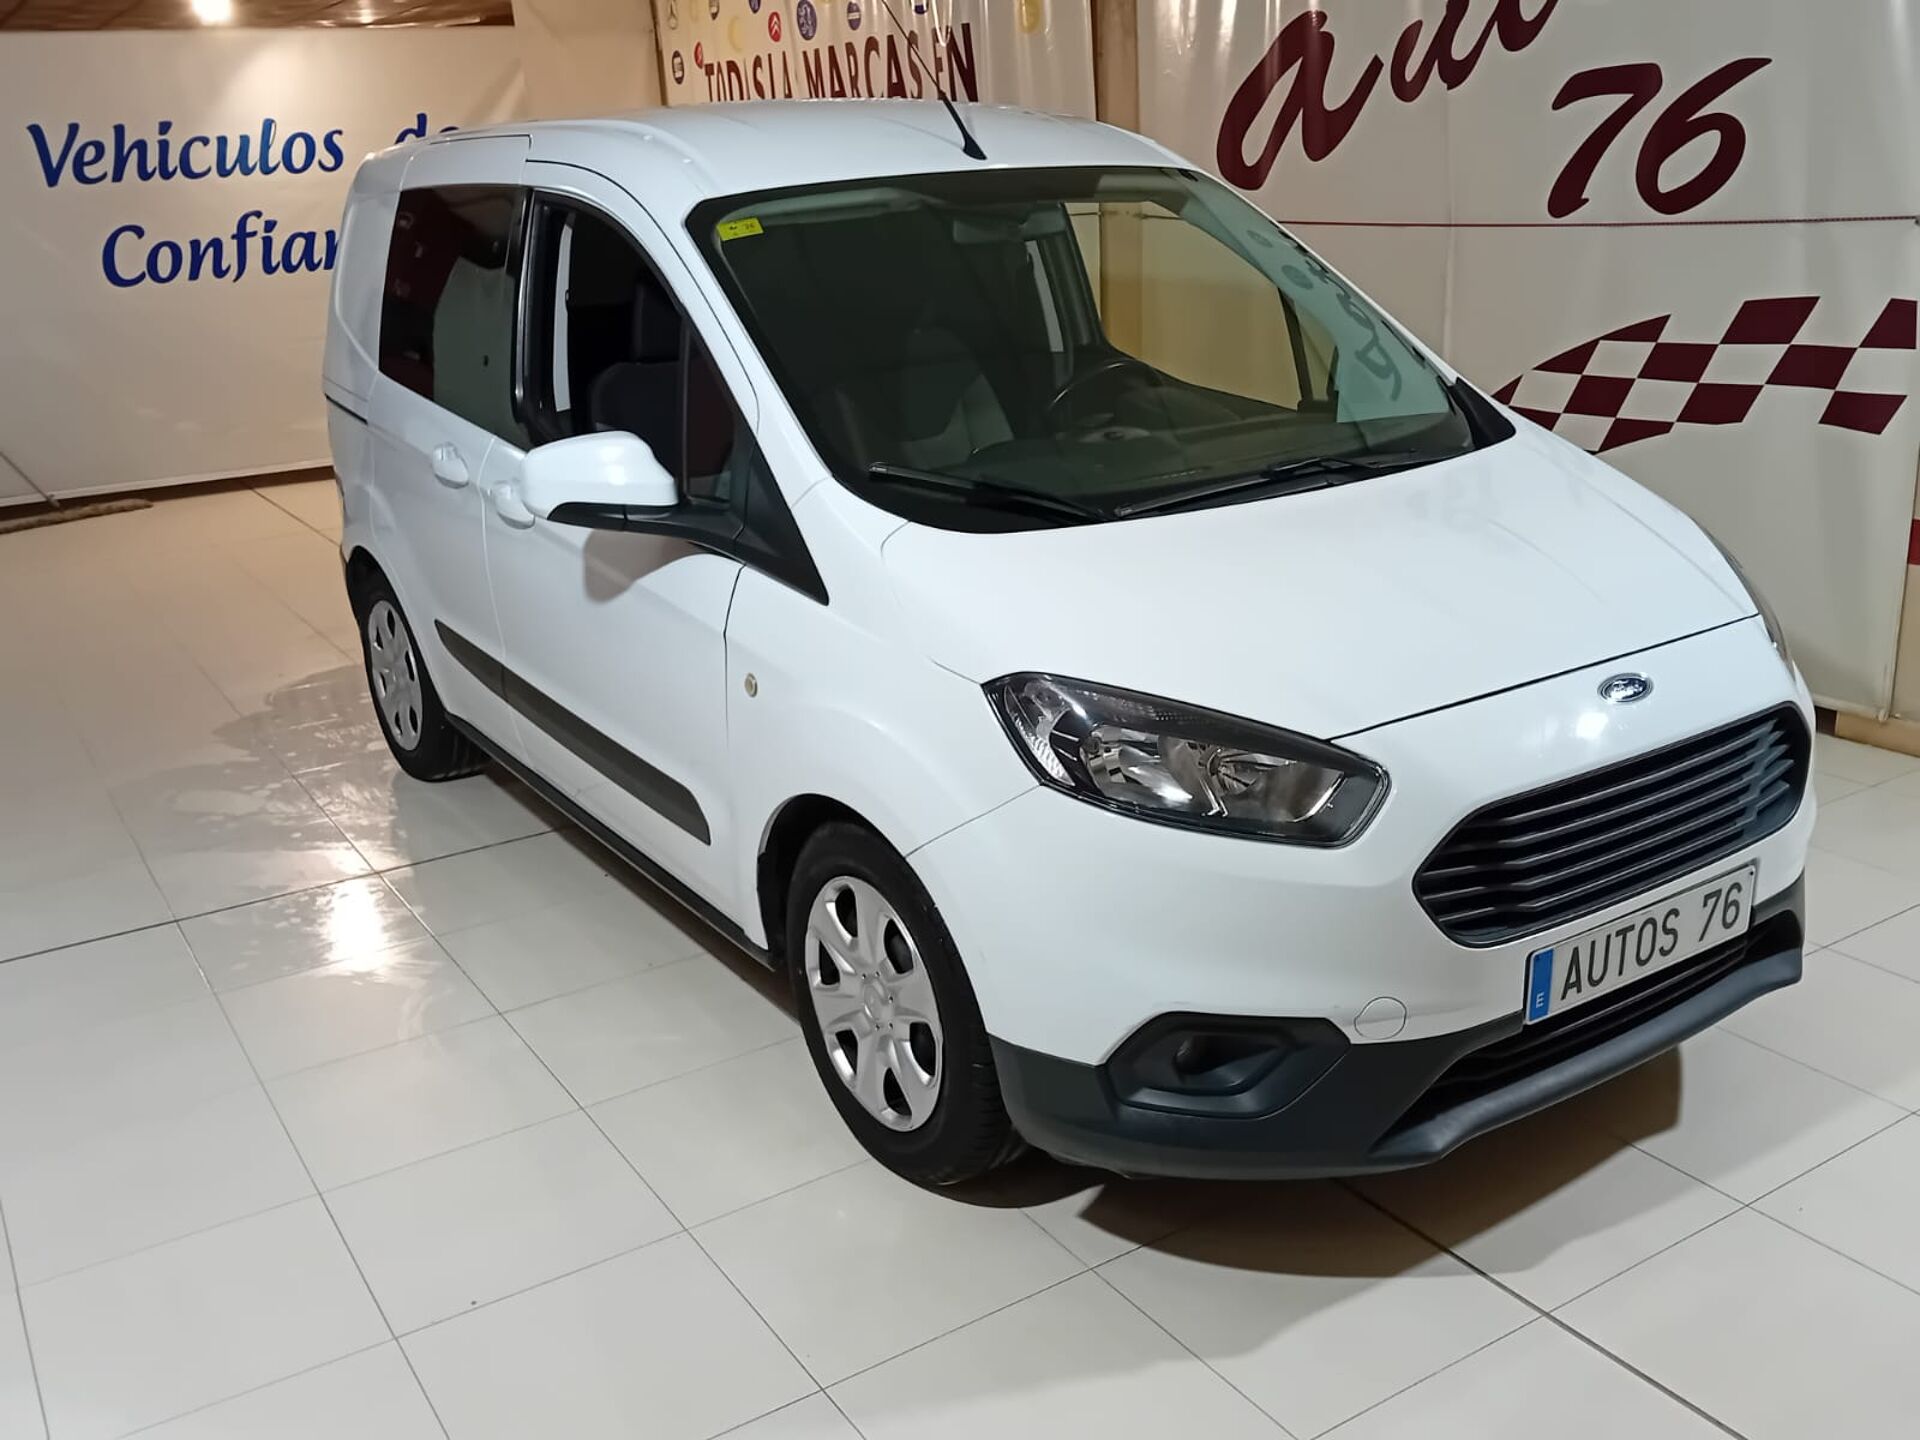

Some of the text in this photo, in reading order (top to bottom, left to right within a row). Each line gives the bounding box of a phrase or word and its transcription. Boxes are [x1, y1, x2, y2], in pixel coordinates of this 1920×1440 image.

[802, 30, 922, 99] MARCAS
[27, 118, 344, 188] Vehiculos
[1548, 57, 1772, 219] 76
[1561, 882, 1742, 1001] AUTOS 76
